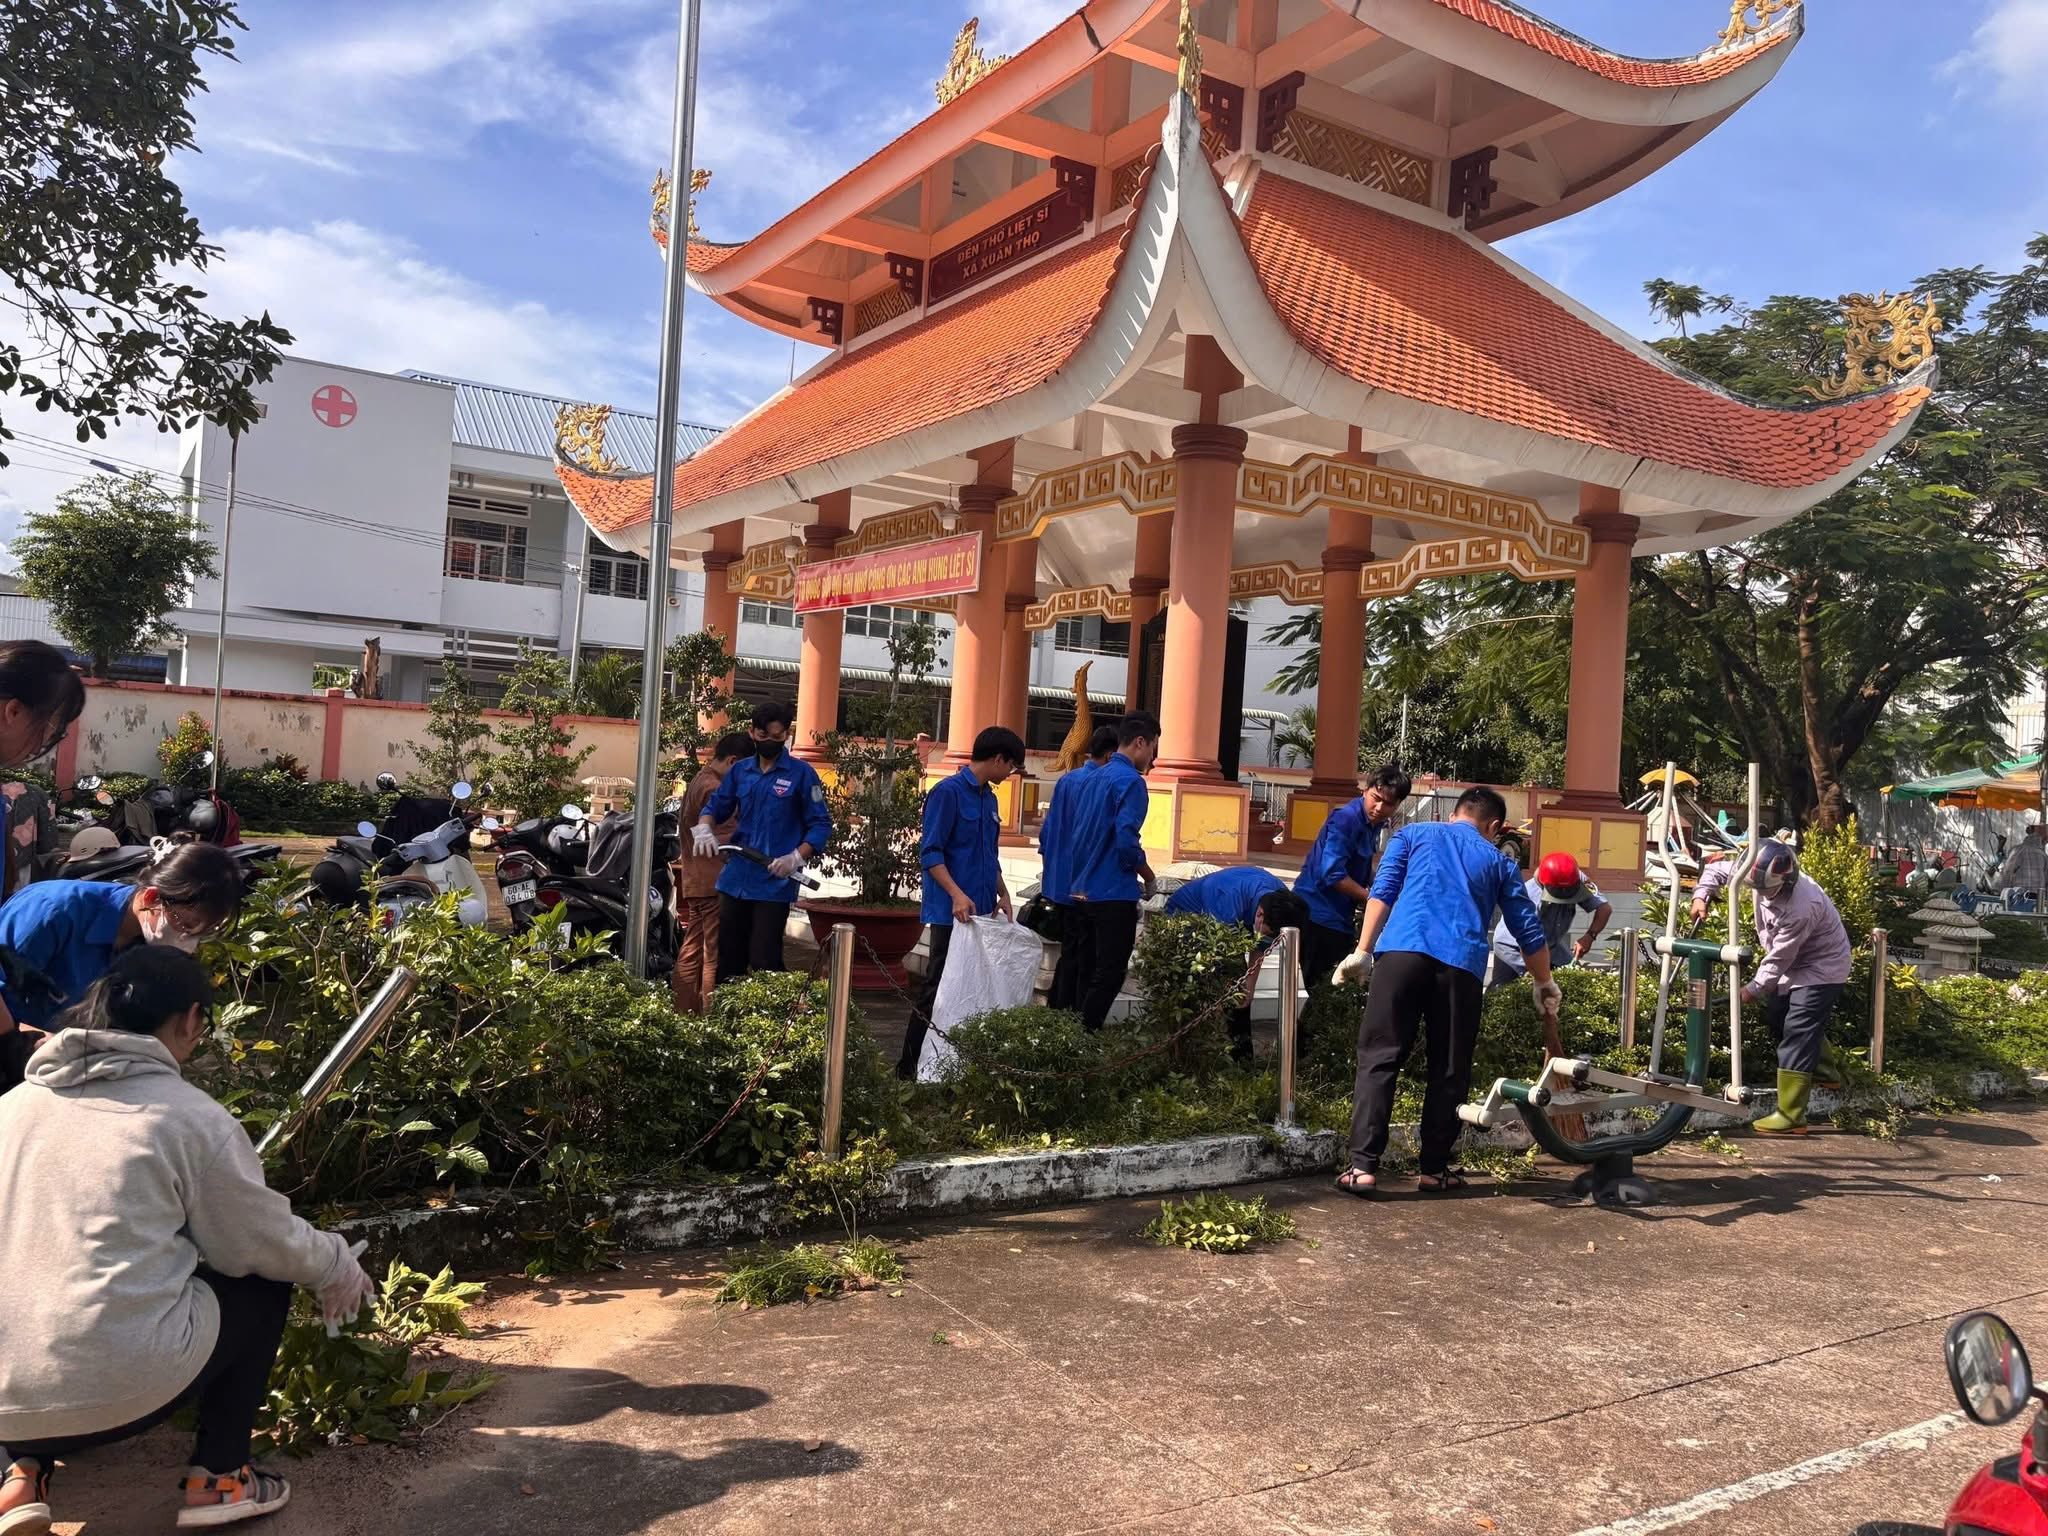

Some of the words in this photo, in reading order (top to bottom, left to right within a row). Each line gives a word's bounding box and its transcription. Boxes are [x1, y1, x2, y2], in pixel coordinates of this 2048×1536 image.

[981, 244, 1012, 271] XUÂN
[1016, 231, 1039, 250] THỌ
[912, 559, 928, 584] ANH
[928, 551, 948, 582] HÙNG
[949, 547, 965, 584] LIỆT
